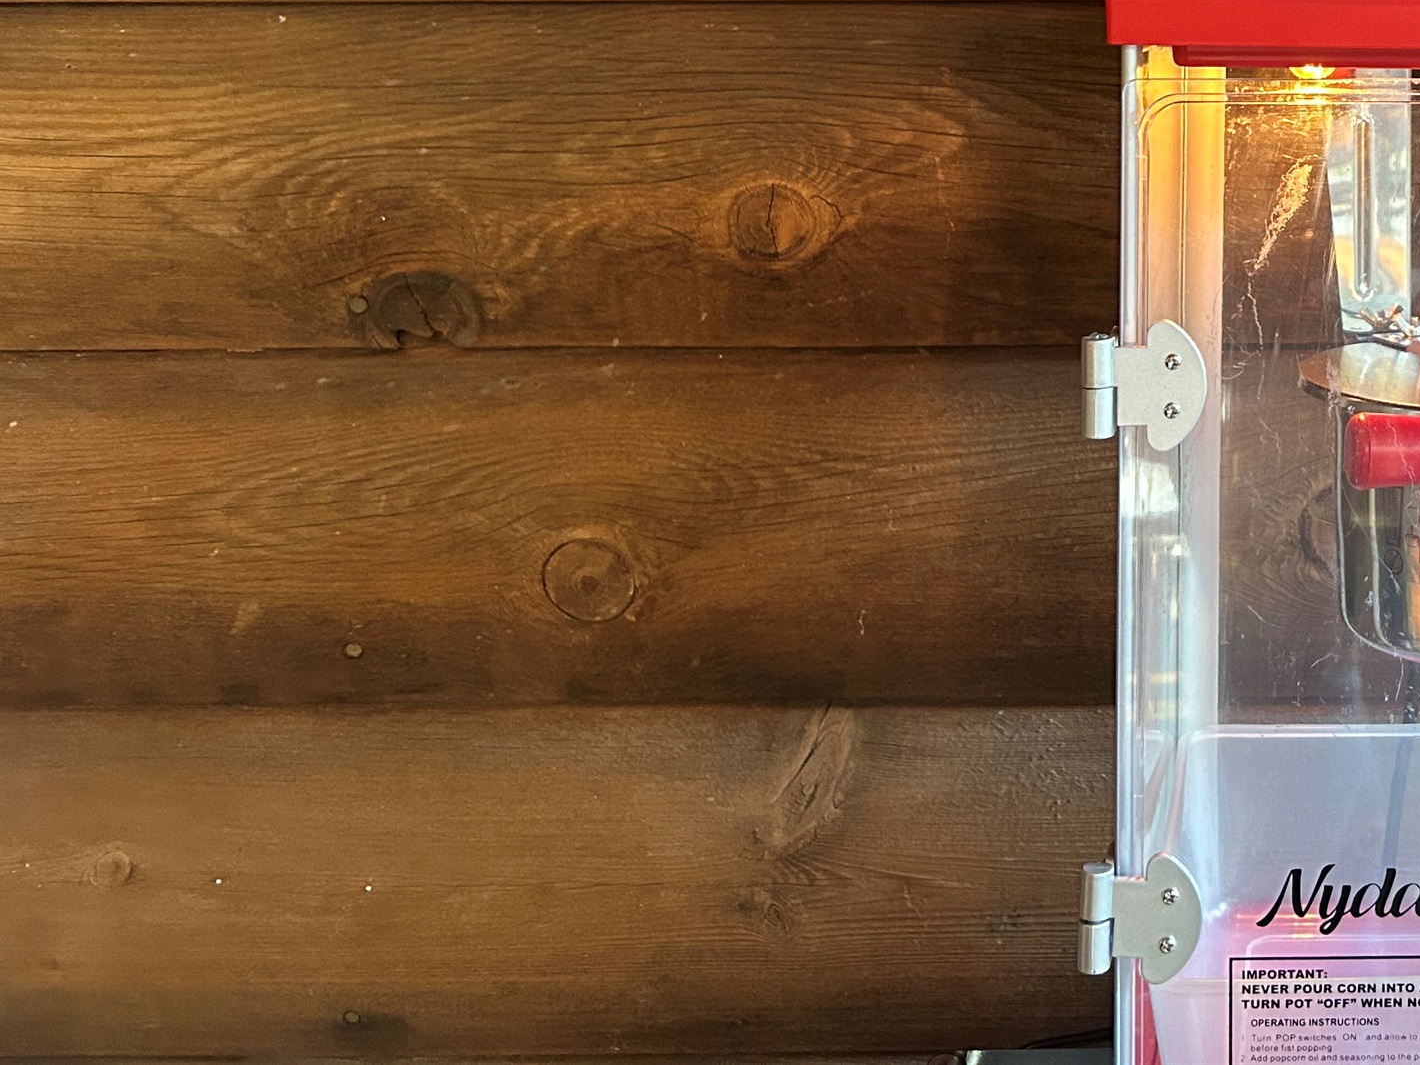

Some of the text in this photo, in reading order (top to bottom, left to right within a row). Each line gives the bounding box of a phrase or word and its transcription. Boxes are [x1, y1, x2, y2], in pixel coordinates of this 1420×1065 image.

[1241, 969, 1328, 979] IMPORTANT:
[1241, 984, 1289, 994] NEVER
[1293, 983, 1332, 994] POUR
[1337, 983, 1377, 993] CORN
[1381, 983, 1415, 993] INTO
[1241, 999, 1280, 1009] TURN
[1285, 998, 1313, 1008] POT
[1360, 998, 1402, 1008] WHEN
[1250, 1017, 1379, 1027] OPERATING INSTRUCTIONS
[1251, 1034, 1271, 1042] Turn
[1298, 1033, 1337, 1041] switches
[1365, 1033, 1382, 1041] and
[1384, 1033, 1407, 1041] allow
[1409, 1033, 1418, 1041] to
[1250, 1044, 1279, 1052] before
[1296, 1044, 1333, 1053] popping
[1250, 1054, 1268, 1062] Add
[1269, 1055, 1307, 1063] popcorn
[1308, 1054, 1319, 1062] oil
[1320, 1054, 1338, 1062] and
[1339, 1053, 1385, 1063] seasoning
[1387, 1053, 1396, 1061] to
[1397, 1053, 1412, 1061] the
